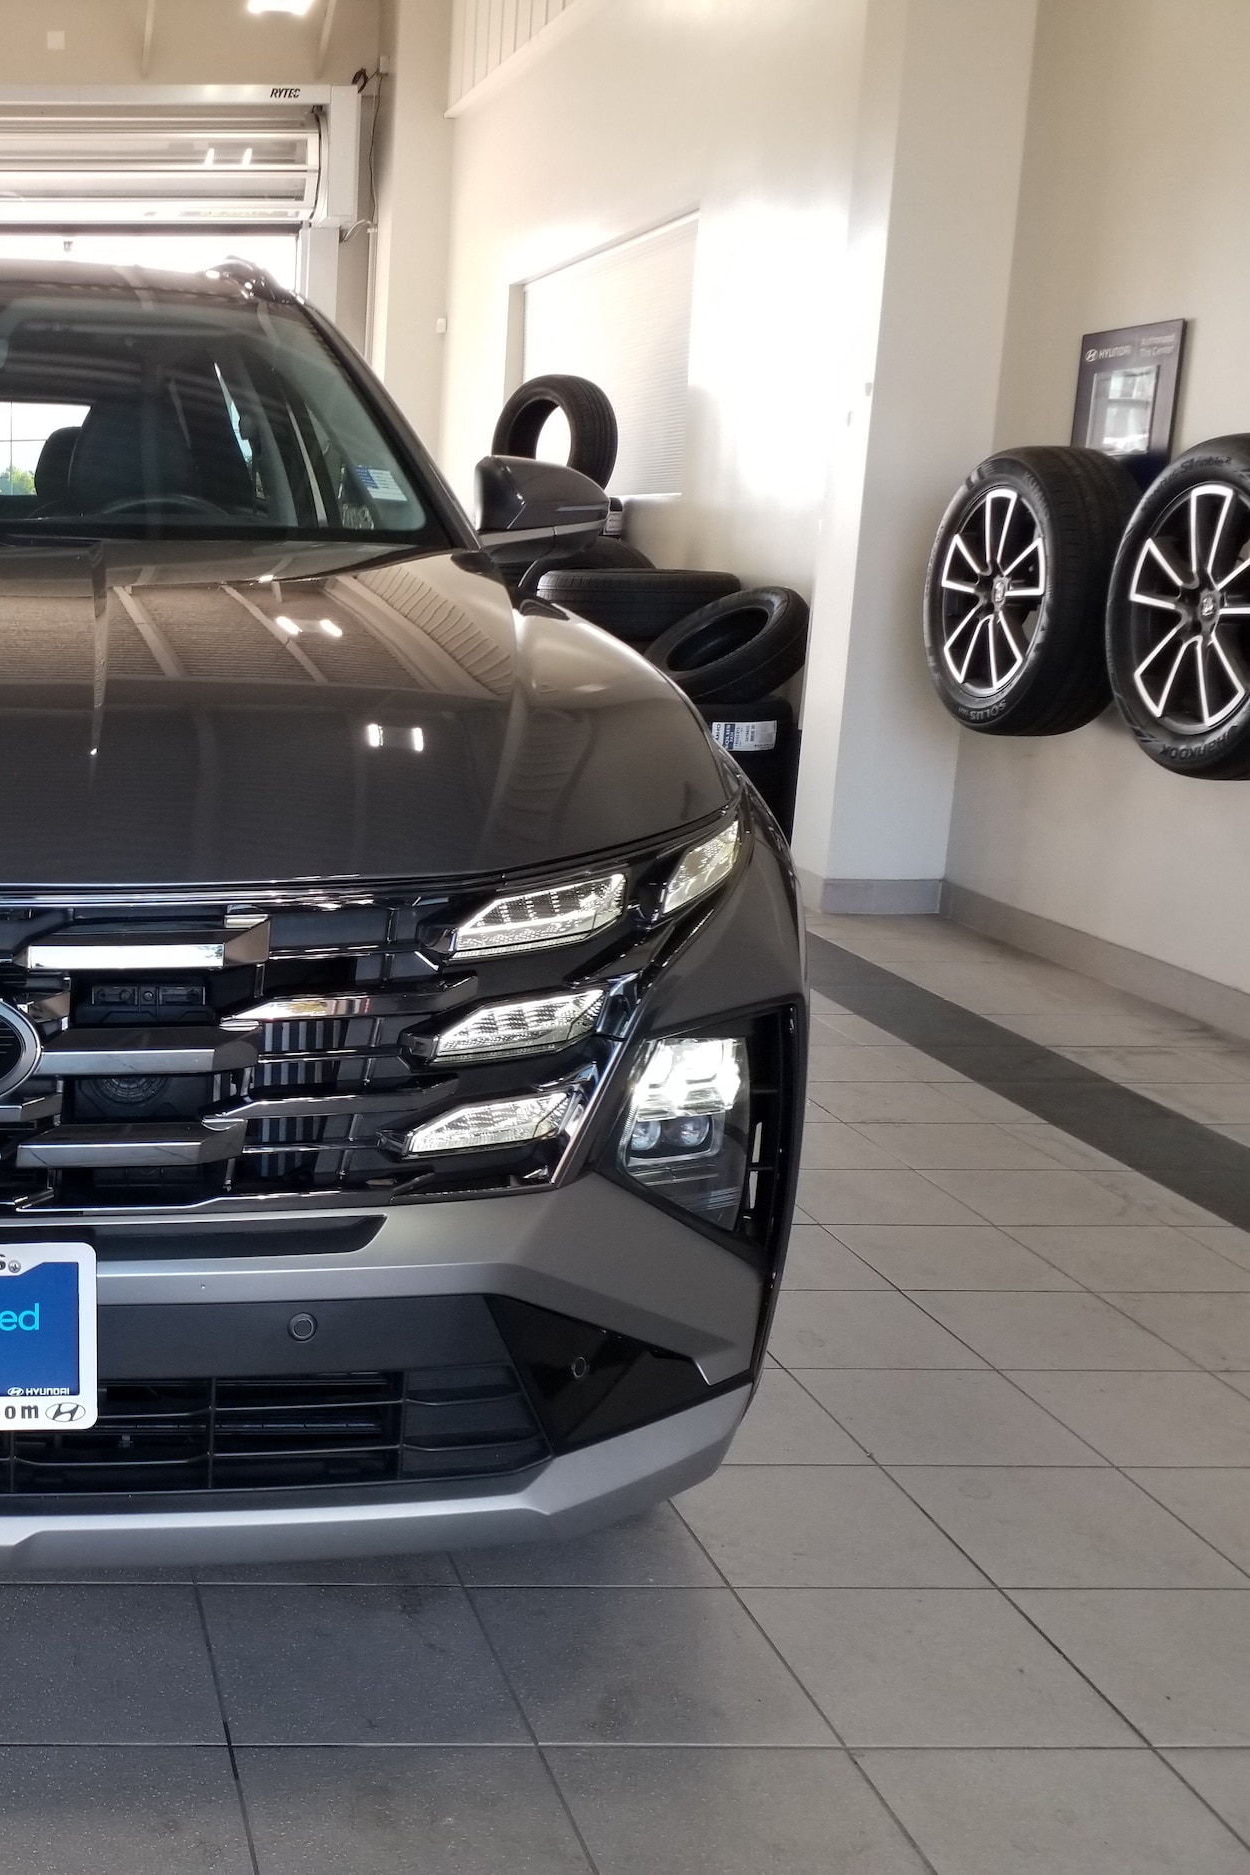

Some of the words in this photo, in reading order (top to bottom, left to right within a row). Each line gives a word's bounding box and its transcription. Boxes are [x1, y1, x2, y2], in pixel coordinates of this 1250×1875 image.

[270, 88, 301, 98] RYTEC
[1099, 345, 1132, 359] HYUNDAI
[25, 1387, 70, 1397] HYUNDAI
